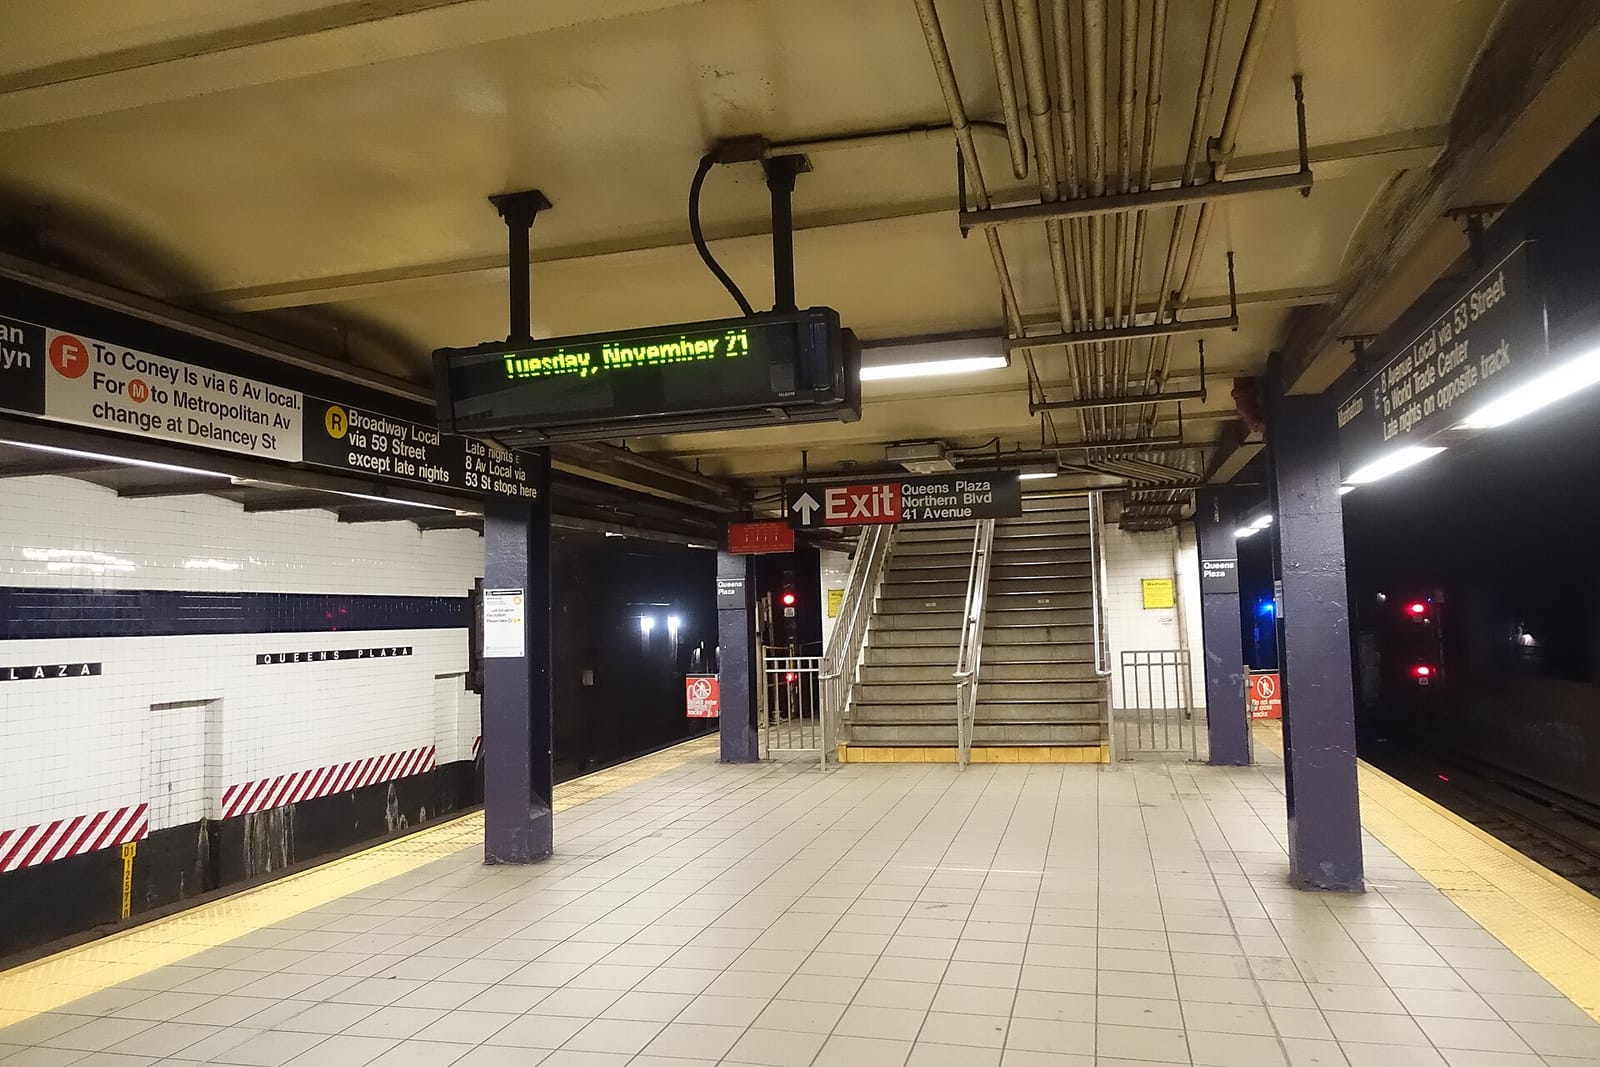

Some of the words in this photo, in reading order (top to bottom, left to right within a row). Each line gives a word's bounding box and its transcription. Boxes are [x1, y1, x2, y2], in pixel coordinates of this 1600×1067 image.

[1381, 371, 1387, 393] 8
[1388, 355, 1412, 388] Avenue
[1414, 330, 1437, 368] Local
[1438, 321, 1452, 347] via
[1454, 303, 1468, 335] 53
[1470, 271, 1506, 321] Street
[62, 344, 78, 368] F
[504, 348, 598, 378] Tuesday,
[602, 336, 719, 369] November
[726, 329, 748, 357] 21
[93, 344, 116, 366] To
[122, 351, 179, 385] Coney
[184, 367, 198, 385] Is
[203, 374, 225, 392] via
[229, 380, 238, 395] 6
[243, 382, 261, 400] Av
[265, 387, 300, 410] local.
[1382, 398, 1390, 417] To
[1391, 378, 1412, 410] World
[1413, 364, 1435, 395] Trade
[1437, 339, 1469, 378] Center
[1384, 420, 1398, 441] Late
[1399, 402, 1422, 432] nights
[1423, 394, 1436, 415] on
[1437, 365, 1477, 411] opposite
[1480, 339, 1511, 380] track
[93, 372, 125, 394] For
[132, 384, 145, 399] M
[151, 385, 168, 404] to
[174, 390, 269, 425] Metropolitan
[273, 412, 290, 430] Av
[92, 402, 161, 431] change
[167, 415, 183, 433] at
[188, 418, 257, 449] Delancey
[261, 433, 276, 450] St
[331, 412, 341, 431] R
[349, 410, 407, 441] Broadway
[412, 425, 440, 446] Local
[349, 430, 367, 448] via
[371, 435, 388, 452] 59
[392, 439, 426, 460] Street
[465, 439, 485, 456] Late
[488, 448, 513, 463] nights
[515, 455, 520, 464] E
[349, 452, 390, 472] except
[394, 458, 415, 475] late
[419, 463, 449, 483] nights
[465, 455, 472, 470] 8
[476, 458, 486, 472] Av
[489, 461, 512, 478] Local
[514, 467, 526, 481] via
[465, 472, 478, 487] 53
[481, 475, 491, 490] St
[494, 479, 517, 496] stops
[520, 483, 537, 498] here
[902, 483, 949, 496] Queens
[956, 480, 991, 492] Plaza
[902, 494, 957, 508] Northern
[964, 492, 992, 504] Blvd
[825, 485, 894, 519] Exit
[903, 509, 917, 519] 41
[924, 506, 972, 519] Avenue
[264, 650, 339, 664] QUEENS
[358, 648, 407, 659] PLAZA
[11, 664, 90, 680] LAZA
